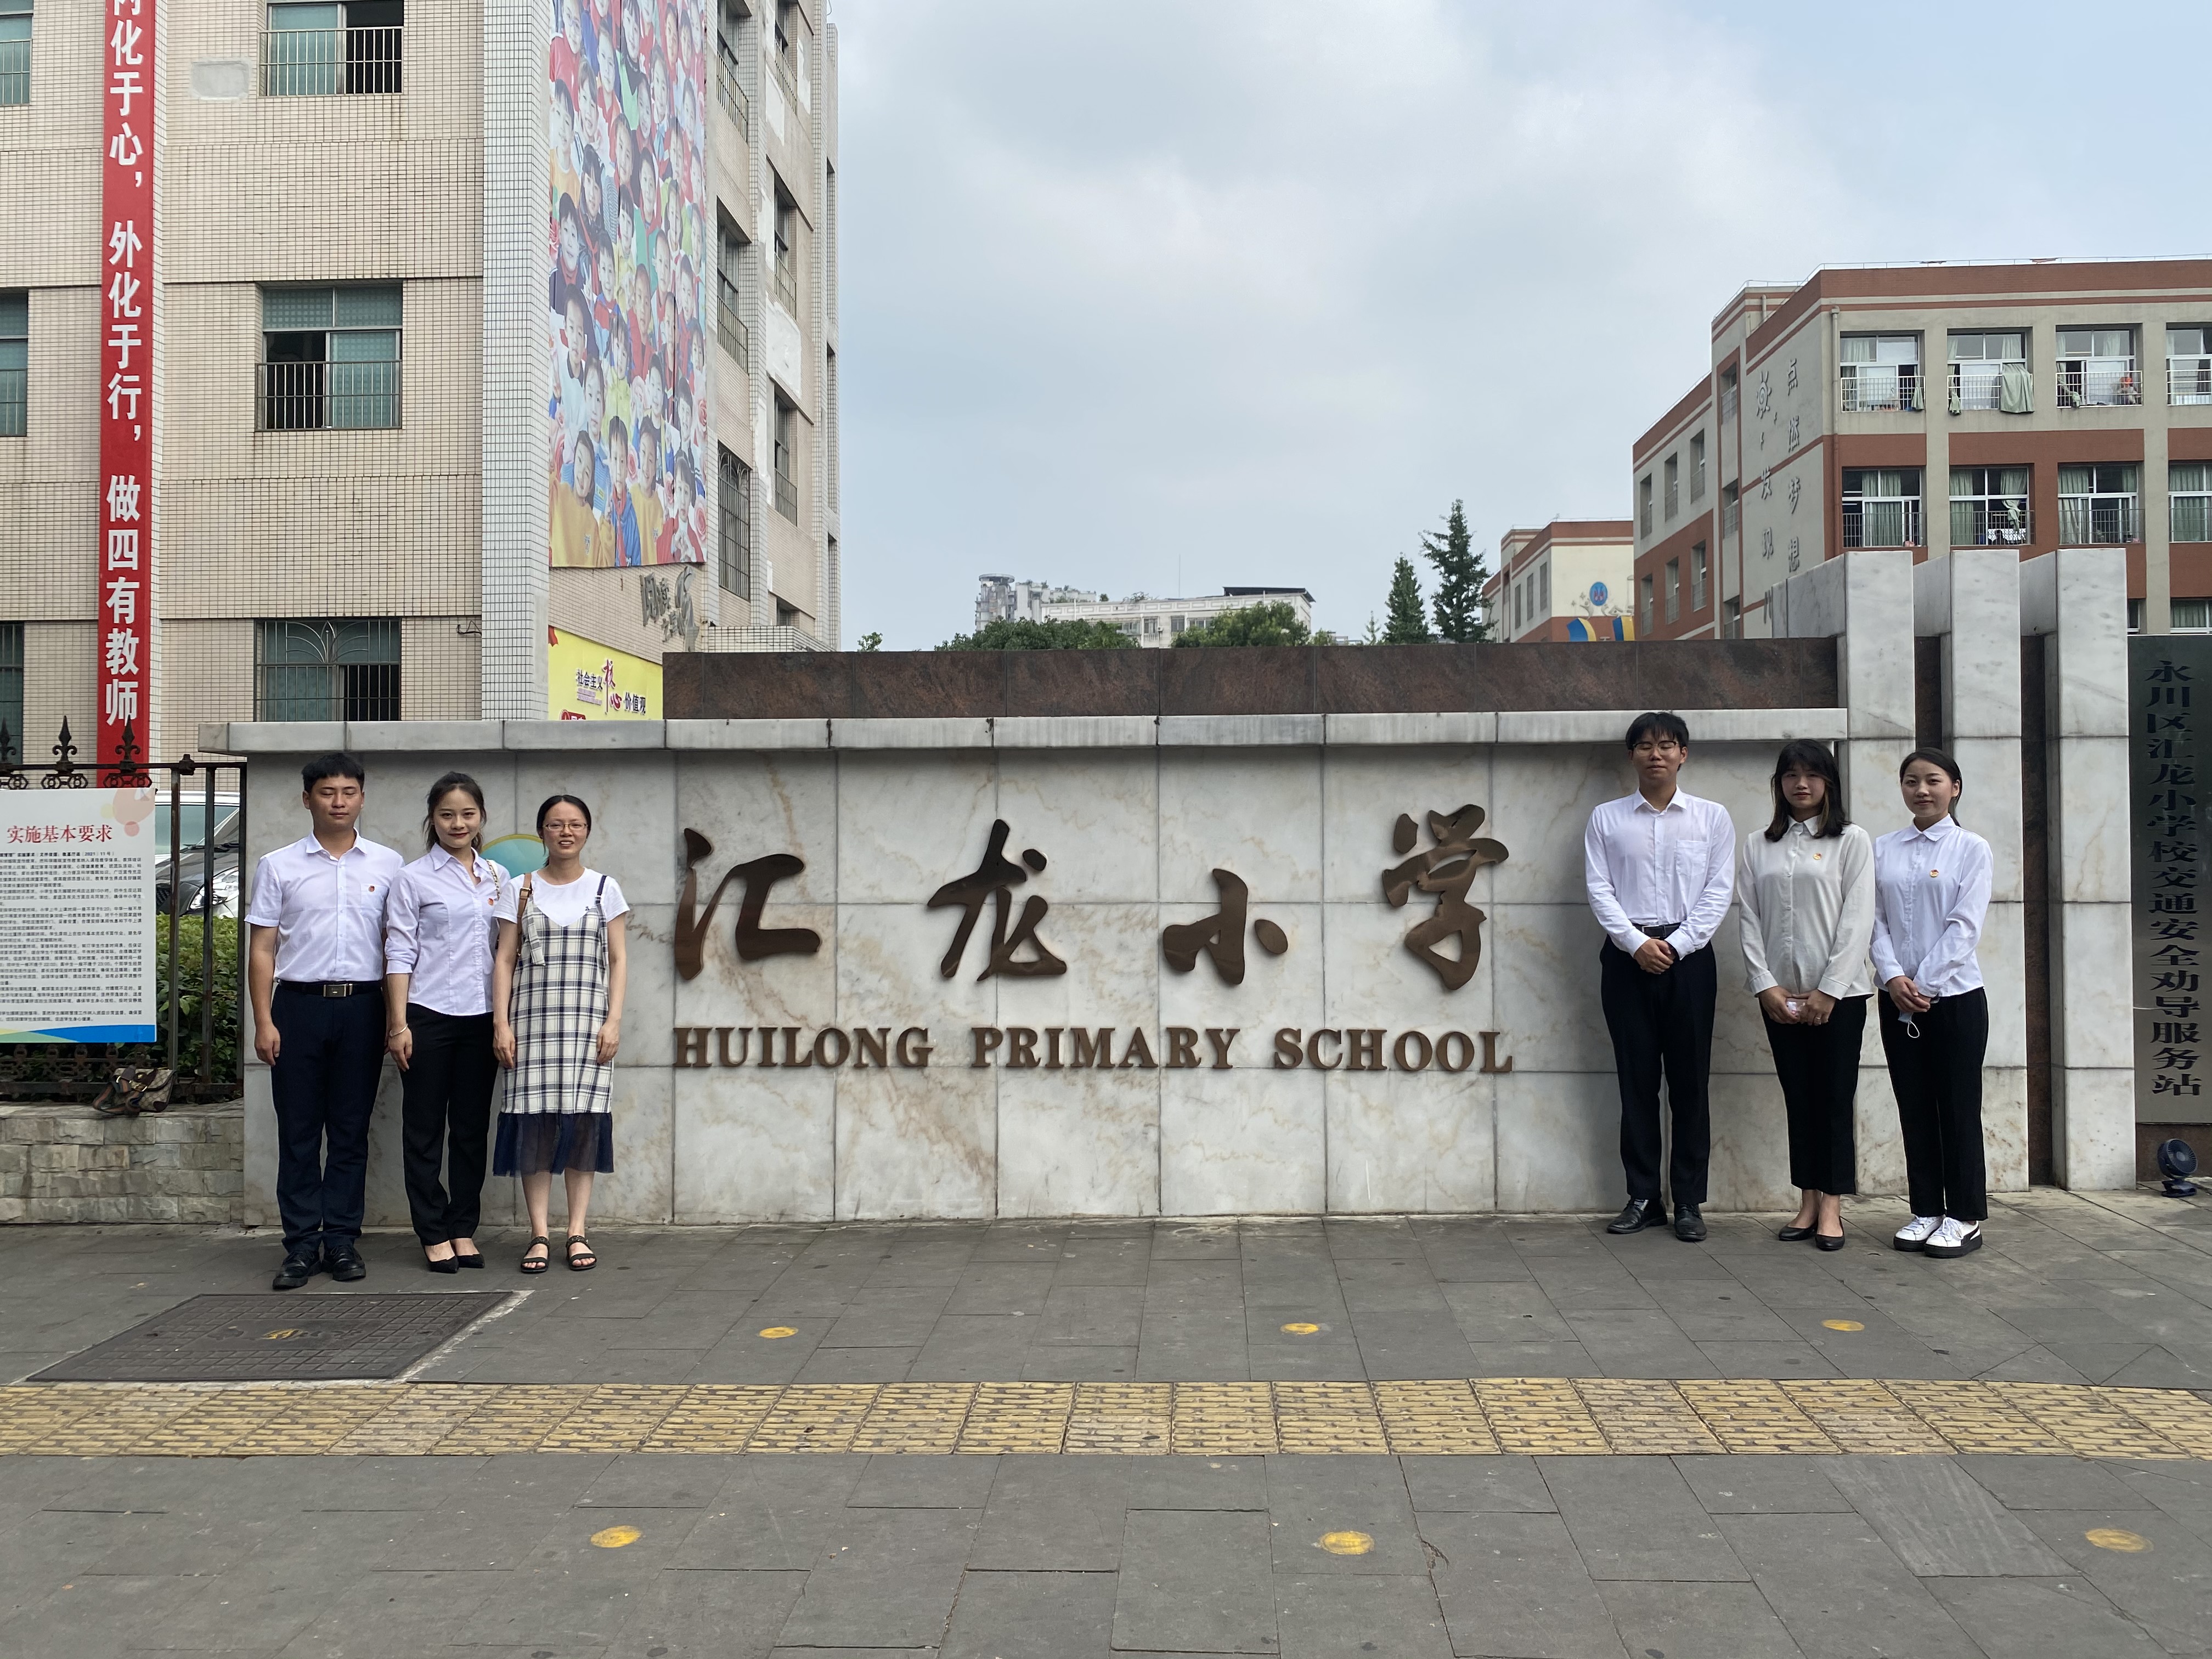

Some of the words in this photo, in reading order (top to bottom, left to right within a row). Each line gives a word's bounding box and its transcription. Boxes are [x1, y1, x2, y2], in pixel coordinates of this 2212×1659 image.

[107, 220, 143, 441] 外化于行，
[1787, 358, 1801, 573] 点燃梦想
[105, 475, 140, 726] 做四有教师
[576, 669, 603, 690] 社会主义
[624, 692, 646, 714] 价值观
[7, 825, 112, 844] 实施基本要求
[675, 804, 1509, 991] 汇龙小学
[2144, 660, 2202, 1096] 永川区汇龙小学校交通安全劝导服务站
[673, 1027, 934, 1069] HUILONG
[970, 1027, 1240, 1069] PRIMARY
[1274, 1028, 1513, 1073] SCHOOL
